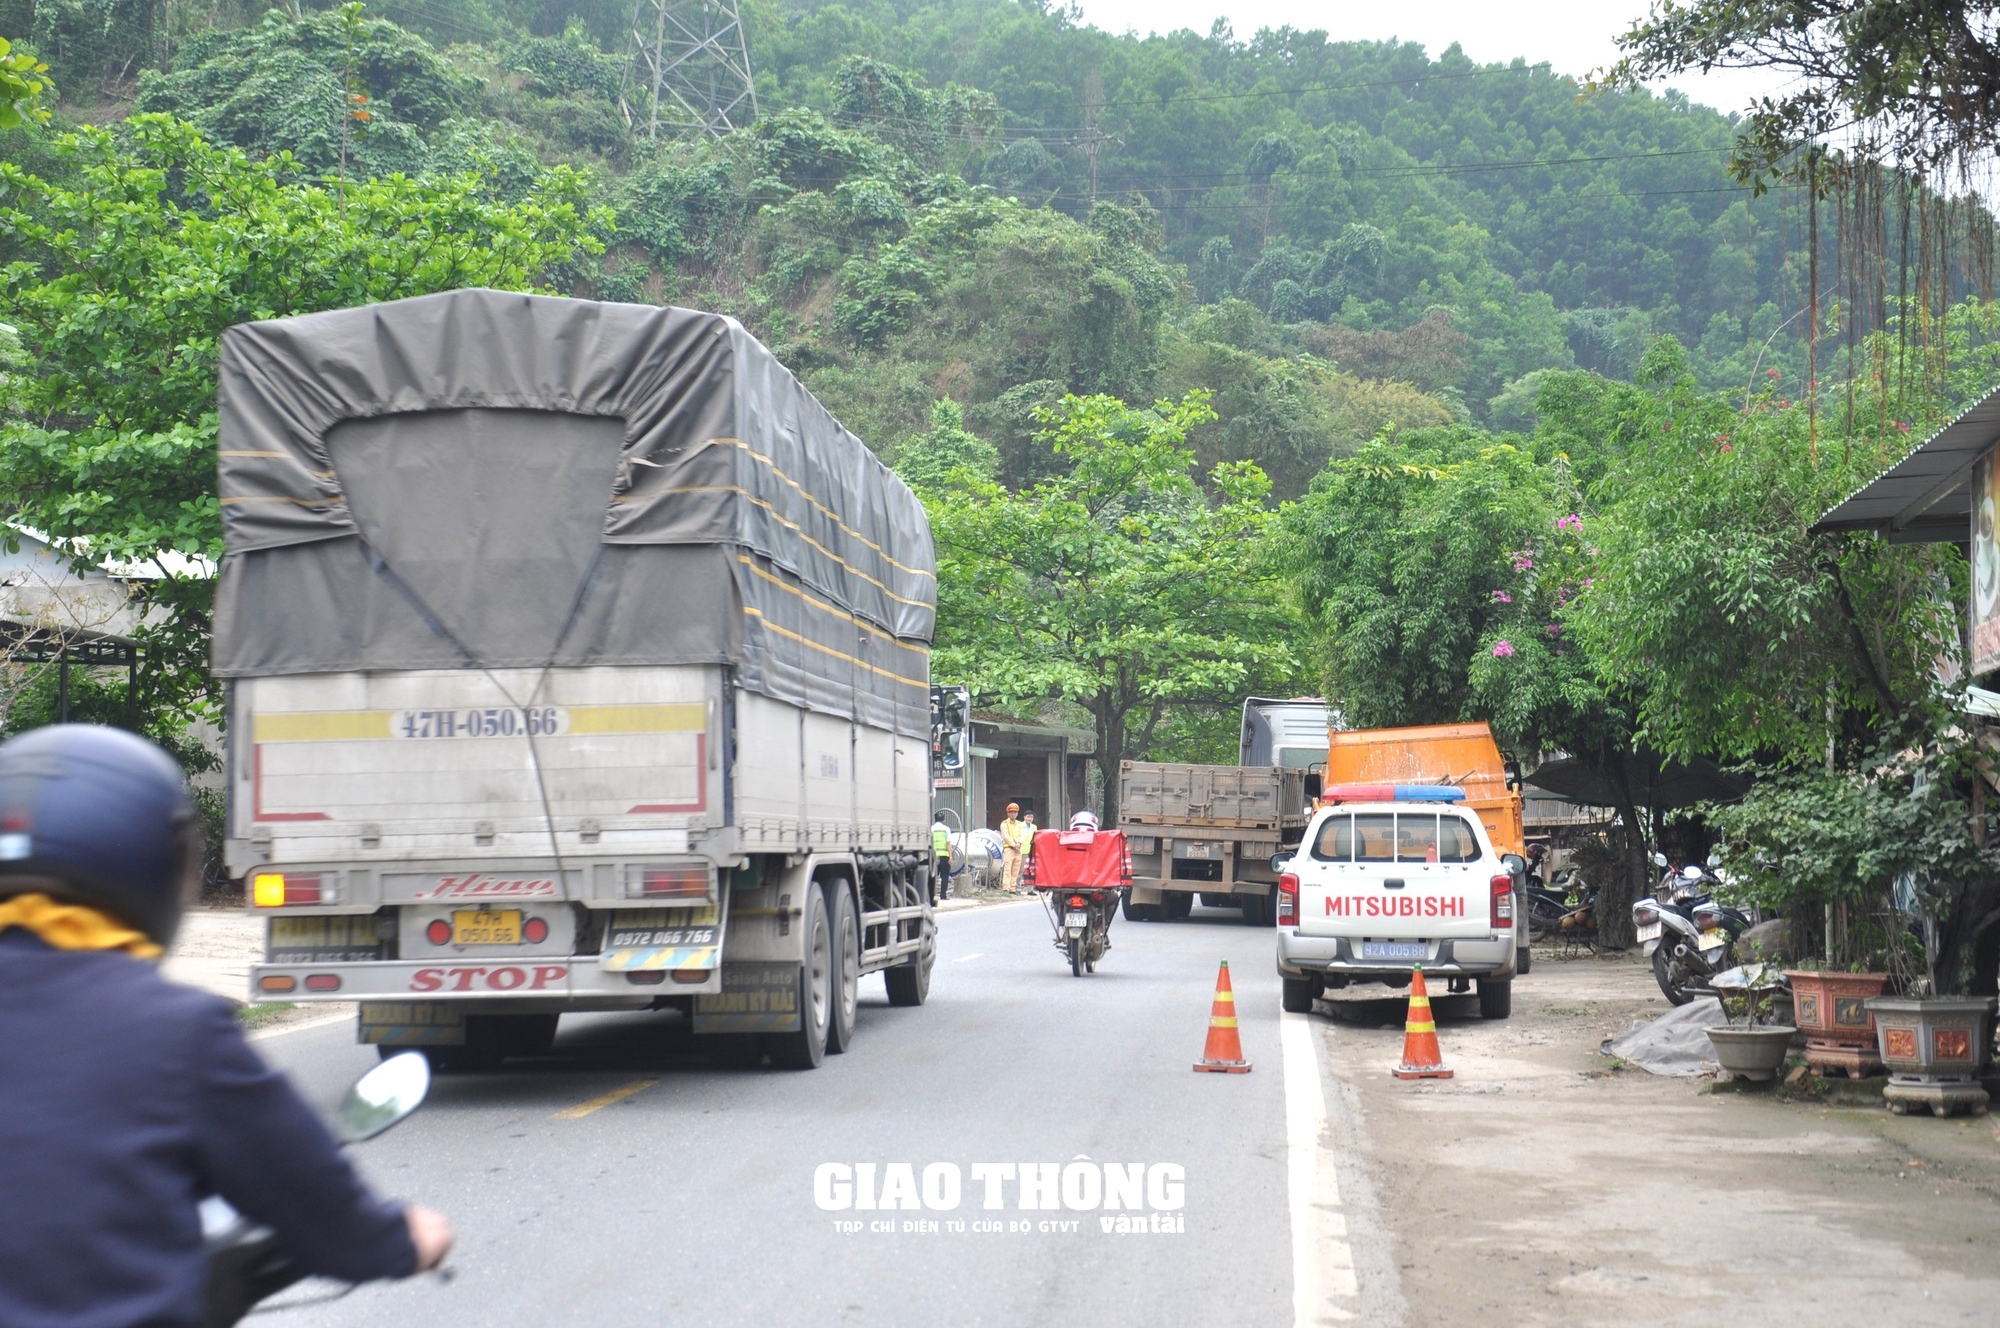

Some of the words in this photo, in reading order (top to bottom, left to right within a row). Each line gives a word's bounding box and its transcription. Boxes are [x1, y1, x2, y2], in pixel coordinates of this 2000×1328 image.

[401, 707, 558, 739] 47H-050.66
[1324, 896, 1465, 917] MITSUBISHI
[472, 912, 502, 926] 47H
[460, 927, 514, 942] 050.66
[612, 931, 652, 946] 0972
[652, 930, 683, 945] 066
[684, 929, 714, 944] 766
[1364, 941, 1386, 957] 92A
[1388, 941, 1426, 957] 005.88
[409, 965, 568, 992] STOP
[762, 970, 793, 984] Auto
